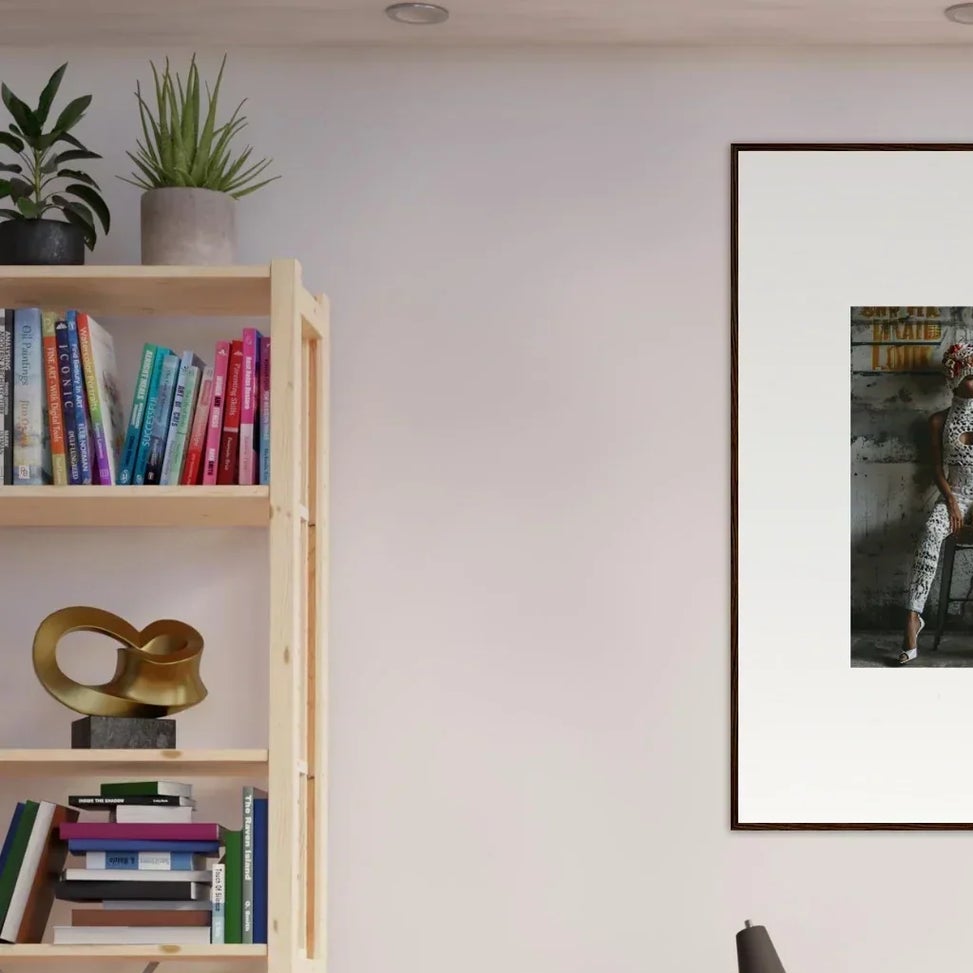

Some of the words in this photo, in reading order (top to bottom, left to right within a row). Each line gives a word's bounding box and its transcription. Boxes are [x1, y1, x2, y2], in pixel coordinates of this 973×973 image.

[21, 325, 31, 338] Oil
[19, 342, 31, 385] Paintings
[45, 346, 56, 364] FINE
[47, 364, 57, 379] ART
[58, 343, 73, 408] ICONIC
[78, 326, 94, 374] Watercolor
[86, 375, 100, 411] Portraits
[229, 362, 241, 397] Parenting
[49, 384, 59, 401] With
[75, 394, 83, 409] ART
[50, 401, 62, 424] Digital
[228, 397, 239, 416] Skills
[52, 425, 63, 442] Tools
[78, 439, 88, 471] NORMAN
[244, 795, 252, 813] The
[244, 817, 252, 847] Raven
[244, 850, 252, 881] Island
